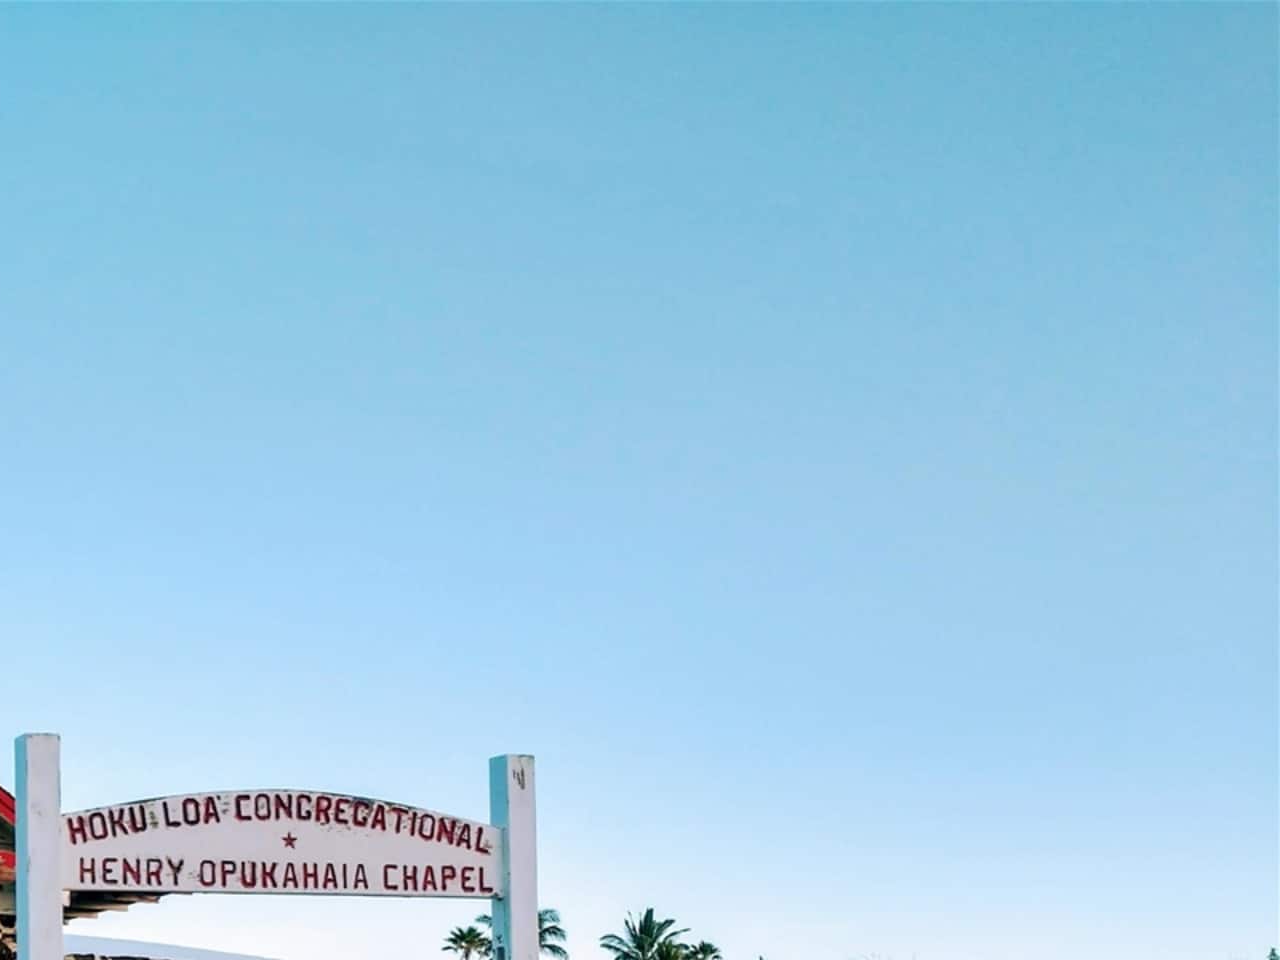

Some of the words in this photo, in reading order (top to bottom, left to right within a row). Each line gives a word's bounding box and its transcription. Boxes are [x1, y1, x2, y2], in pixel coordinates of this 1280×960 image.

[67, 803, 148, 846] HOKU
[162, 796, 221, 828] LOA
[234, 793, 491, 855] CONGREGATIONAL
[79, 856, 185, 887] HENRY
[199, 859, 370, 890] OPUKAHAIA
[383, 863, 494, 894] CHAPEL
